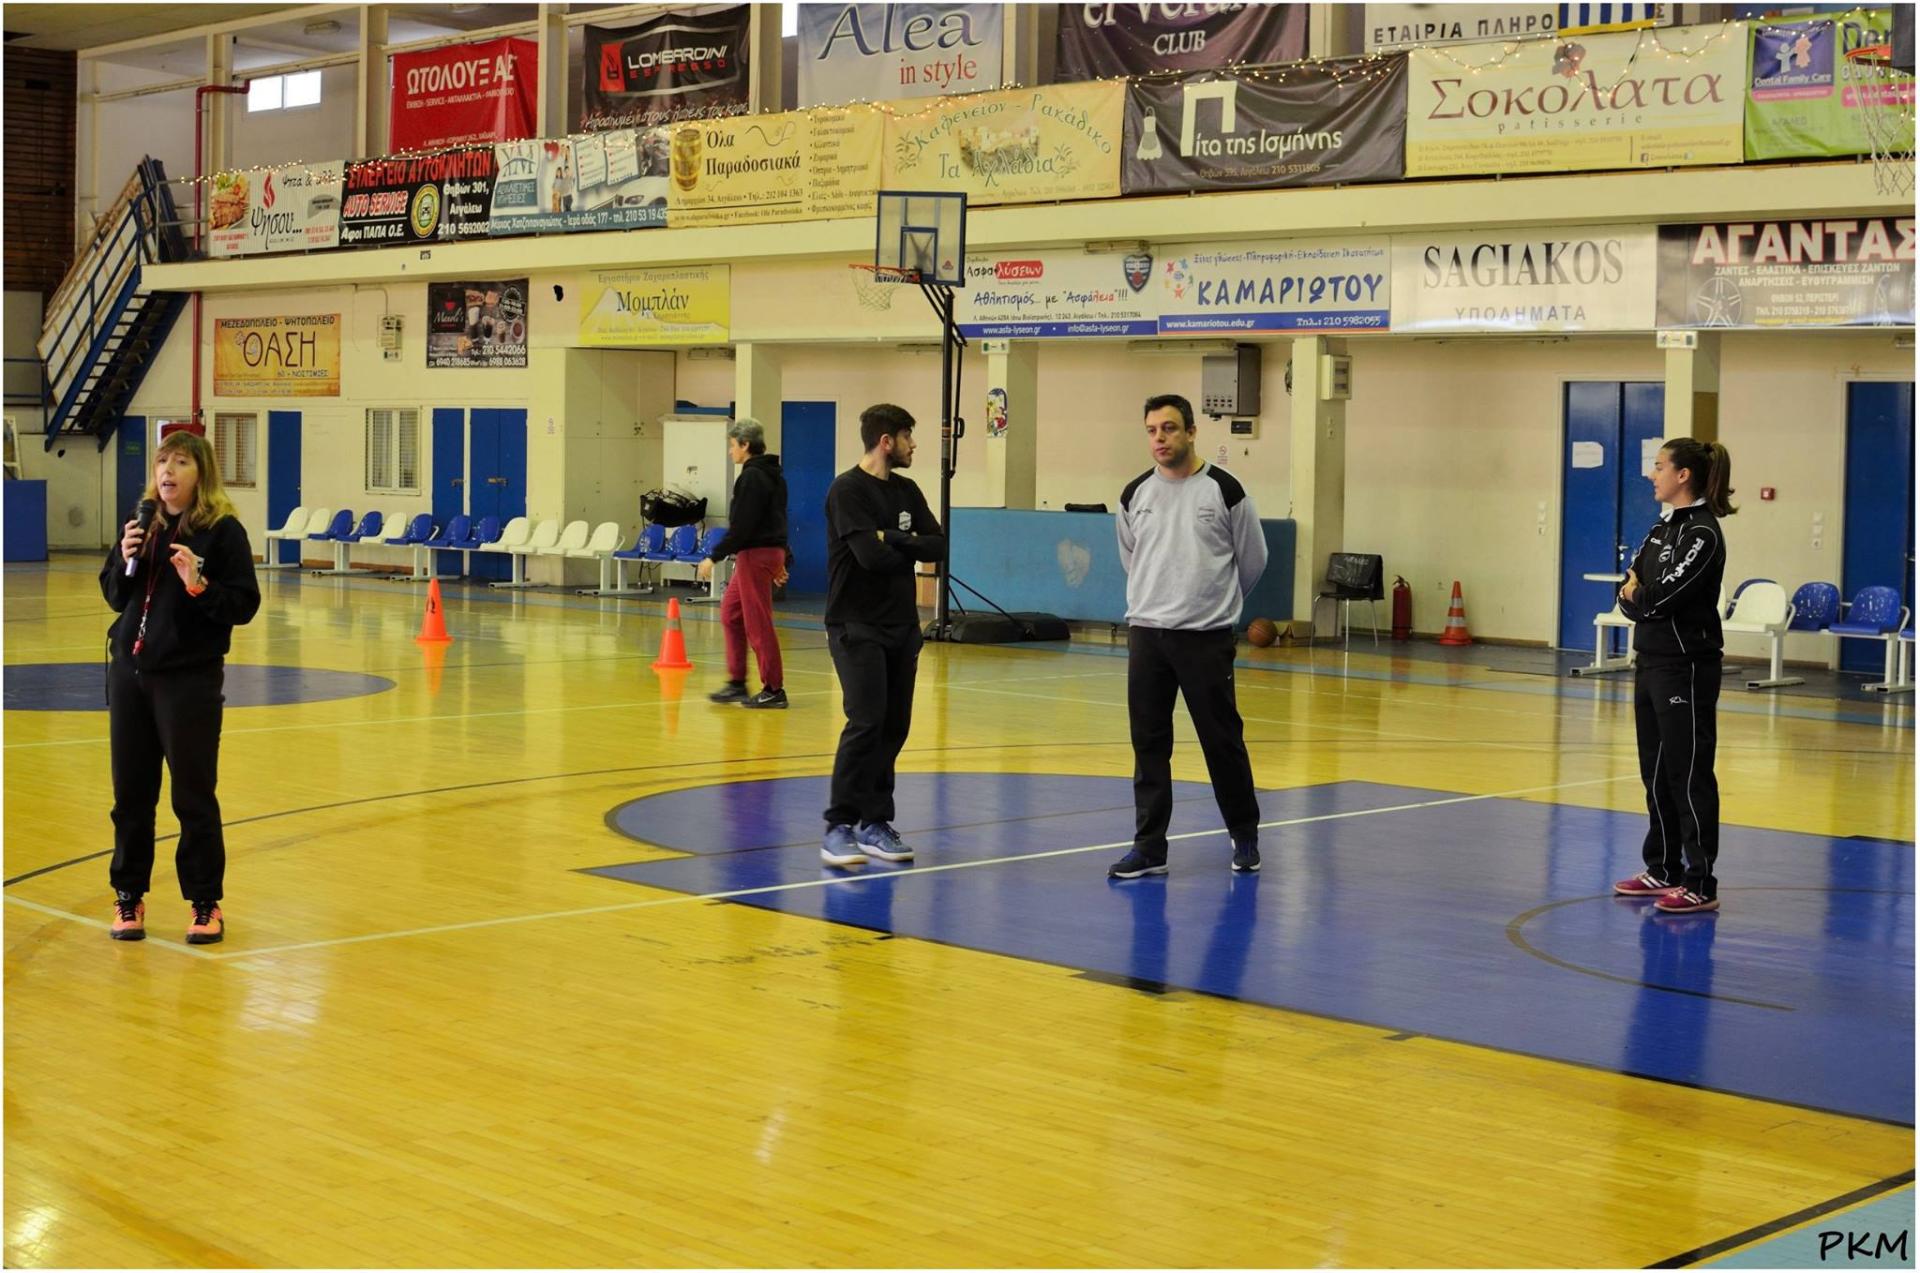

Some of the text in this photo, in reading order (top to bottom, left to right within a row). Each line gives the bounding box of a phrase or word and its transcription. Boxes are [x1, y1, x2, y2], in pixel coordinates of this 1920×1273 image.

[818, 3, 983, 60] Alea
[1153, 30, 1206, 56] CLUB
[1374, 22, 1464, 44] ΕΤΑΙΡΙΑ
[627, 45, 728, 70] LOMBARDINI
[407, 58, 490, 95] ΩΤΟΛΟΥΞ
[900, 53, 978, 89] in style
[1498, 114, 1644, 135] patisserie
[706, 130, 734, 148] Όλα
[1226, 137, 1255, 155] της
[1260, 127, 1342, 159] Ισμήνης
[706, 151, 801, 179] Παραδοσιακά
[939, 152, 960, 179] Τα
[1271, 166, 1287, 174] 210
[443, 181, 489, 197] Θηβών 301,
[343, 193, 370, 218] AUTO
[369, 190, 409, 216] SERVICE
[598, 212, 608, 224] 177
[625, 211, 637, 220] 210
[638, 209, 646, 220] 53
[364, 224, 387, 239] ΠΑΠΑ
[388, 224, 405, 237] Ο.Ε.
[438, 224, 455, 235] 210
[1692, 218, 1915, 265] ΑΓΑΝΤΑΣ
[1423, 239, 1624, 289] SAGIAKOS
[1714, 265, 1750, 275] ΖΑΝΤΕΣ
[1755, 265, 1801, 275] ΕΛΑΣΤΙΚΑ
[1807, 264, 1860, 274] ΕΠΙΣΚΕΥΕΣ
[617, 288, 689, 316] Μομπλάν
[1045, 295, 1058, 309] με
[1197, 273, 1384, 306] ΚΑΜΑΡΙΩΤΟΥ
[1323, 317, 1341, 326] 210
[1455, 305, 1587, 321] ΥΠΟΔΗΜΑΤΑ
[243, 331, 316, 367] ΟΑΣΗ
